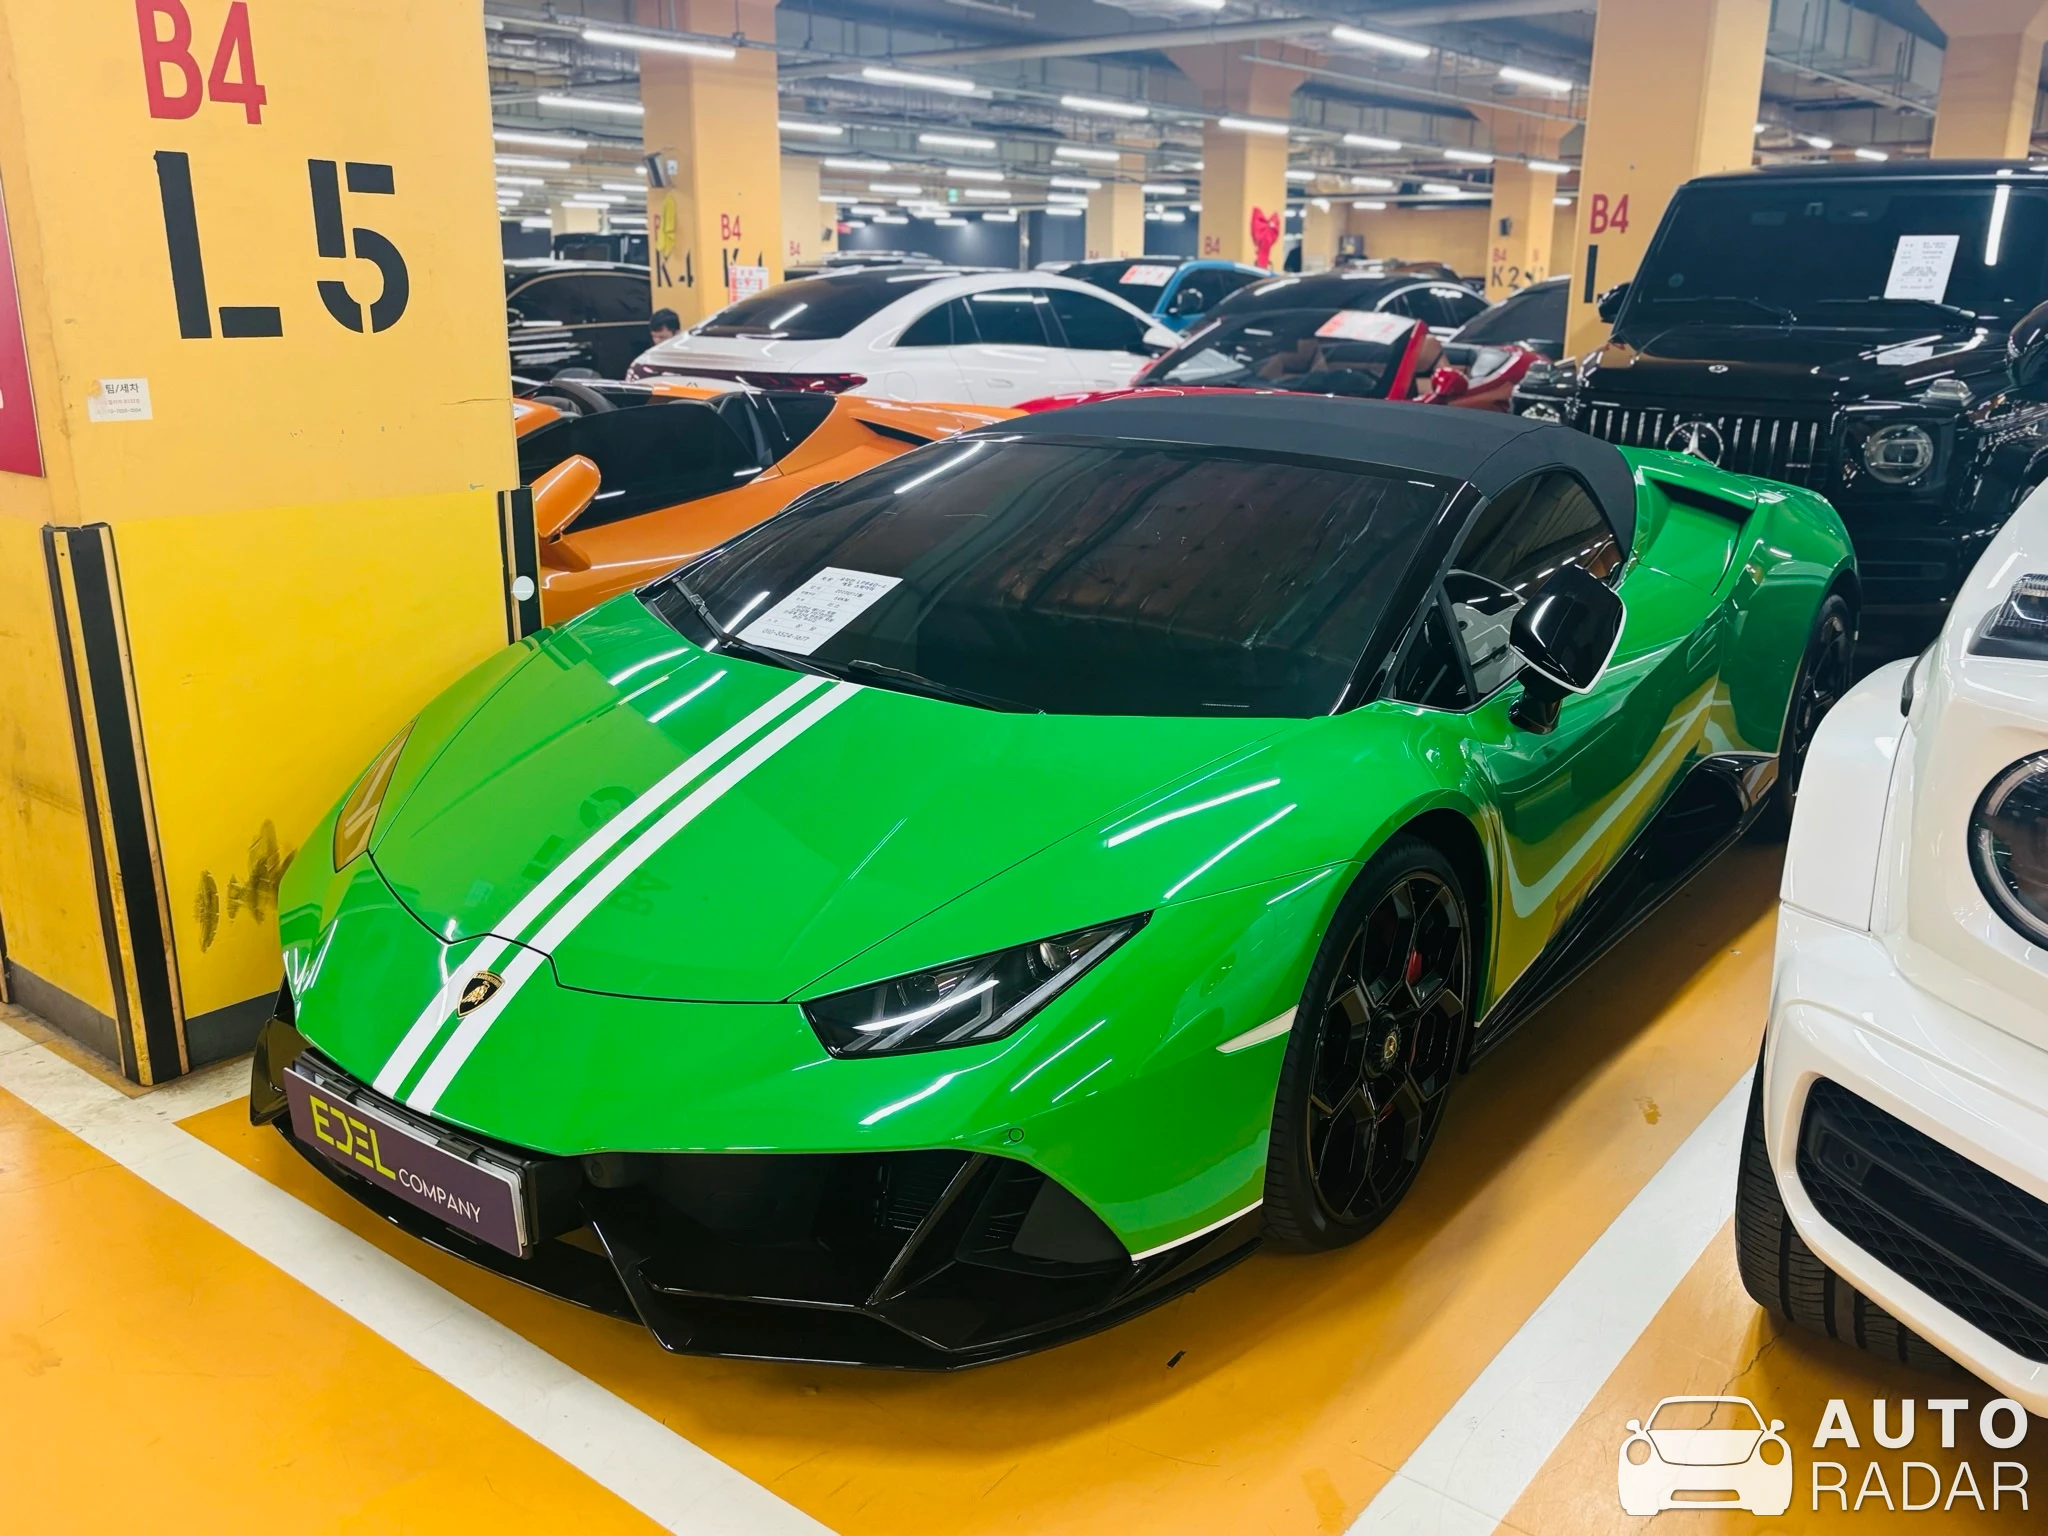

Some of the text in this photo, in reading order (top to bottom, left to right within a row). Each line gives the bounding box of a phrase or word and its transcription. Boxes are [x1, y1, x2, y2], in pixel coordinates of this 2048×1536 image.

[135, 0, 267, 125] B4
[721, 213, 741, 241] B4
[1589, 194, 1630, 234] B4
[1204, 236, 1220, 255] B4
[398, 1168, 481, 1223] COMPANY
